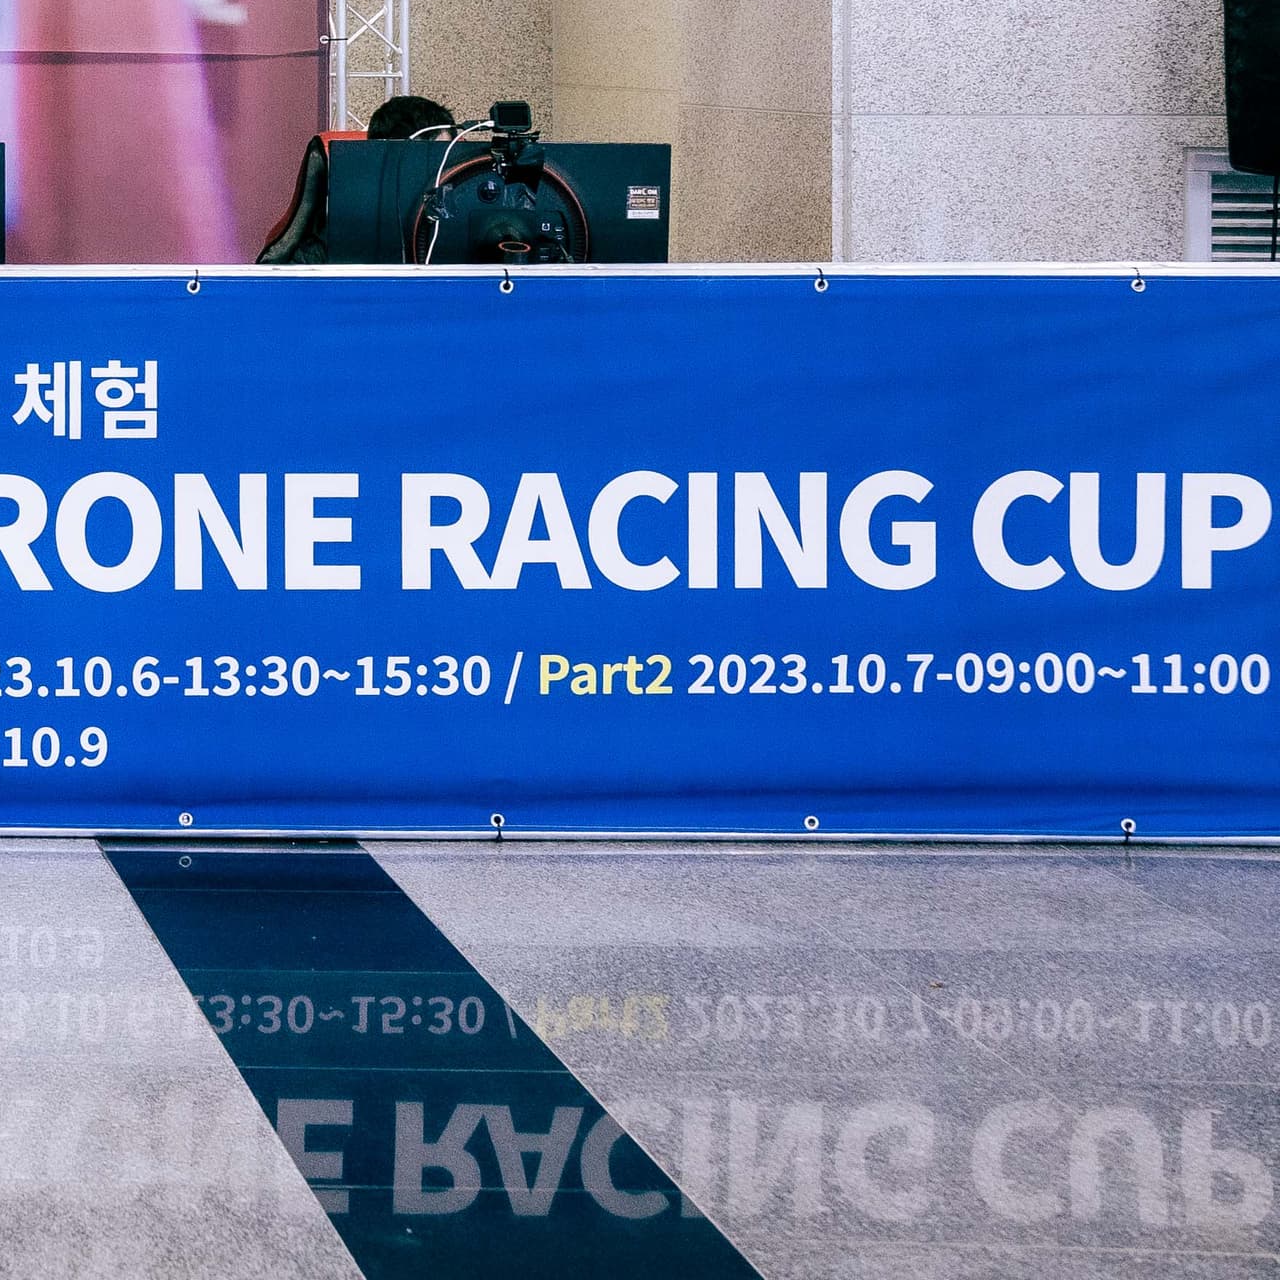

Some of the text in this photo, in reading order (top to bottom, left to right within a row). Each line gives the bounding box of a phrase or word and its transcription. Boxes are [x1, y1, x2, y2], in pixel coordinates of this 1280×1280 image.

[12, 360, 159, 440] 체험
[401, 470, 937, 591] RACING
[972, 470, 1273, 591] CUP
[504, 651, 523, 705] /
[538, 654, 673, 695] Part2
[687, 652, 1270, 695] 2023.10.7-09:00~11:00
